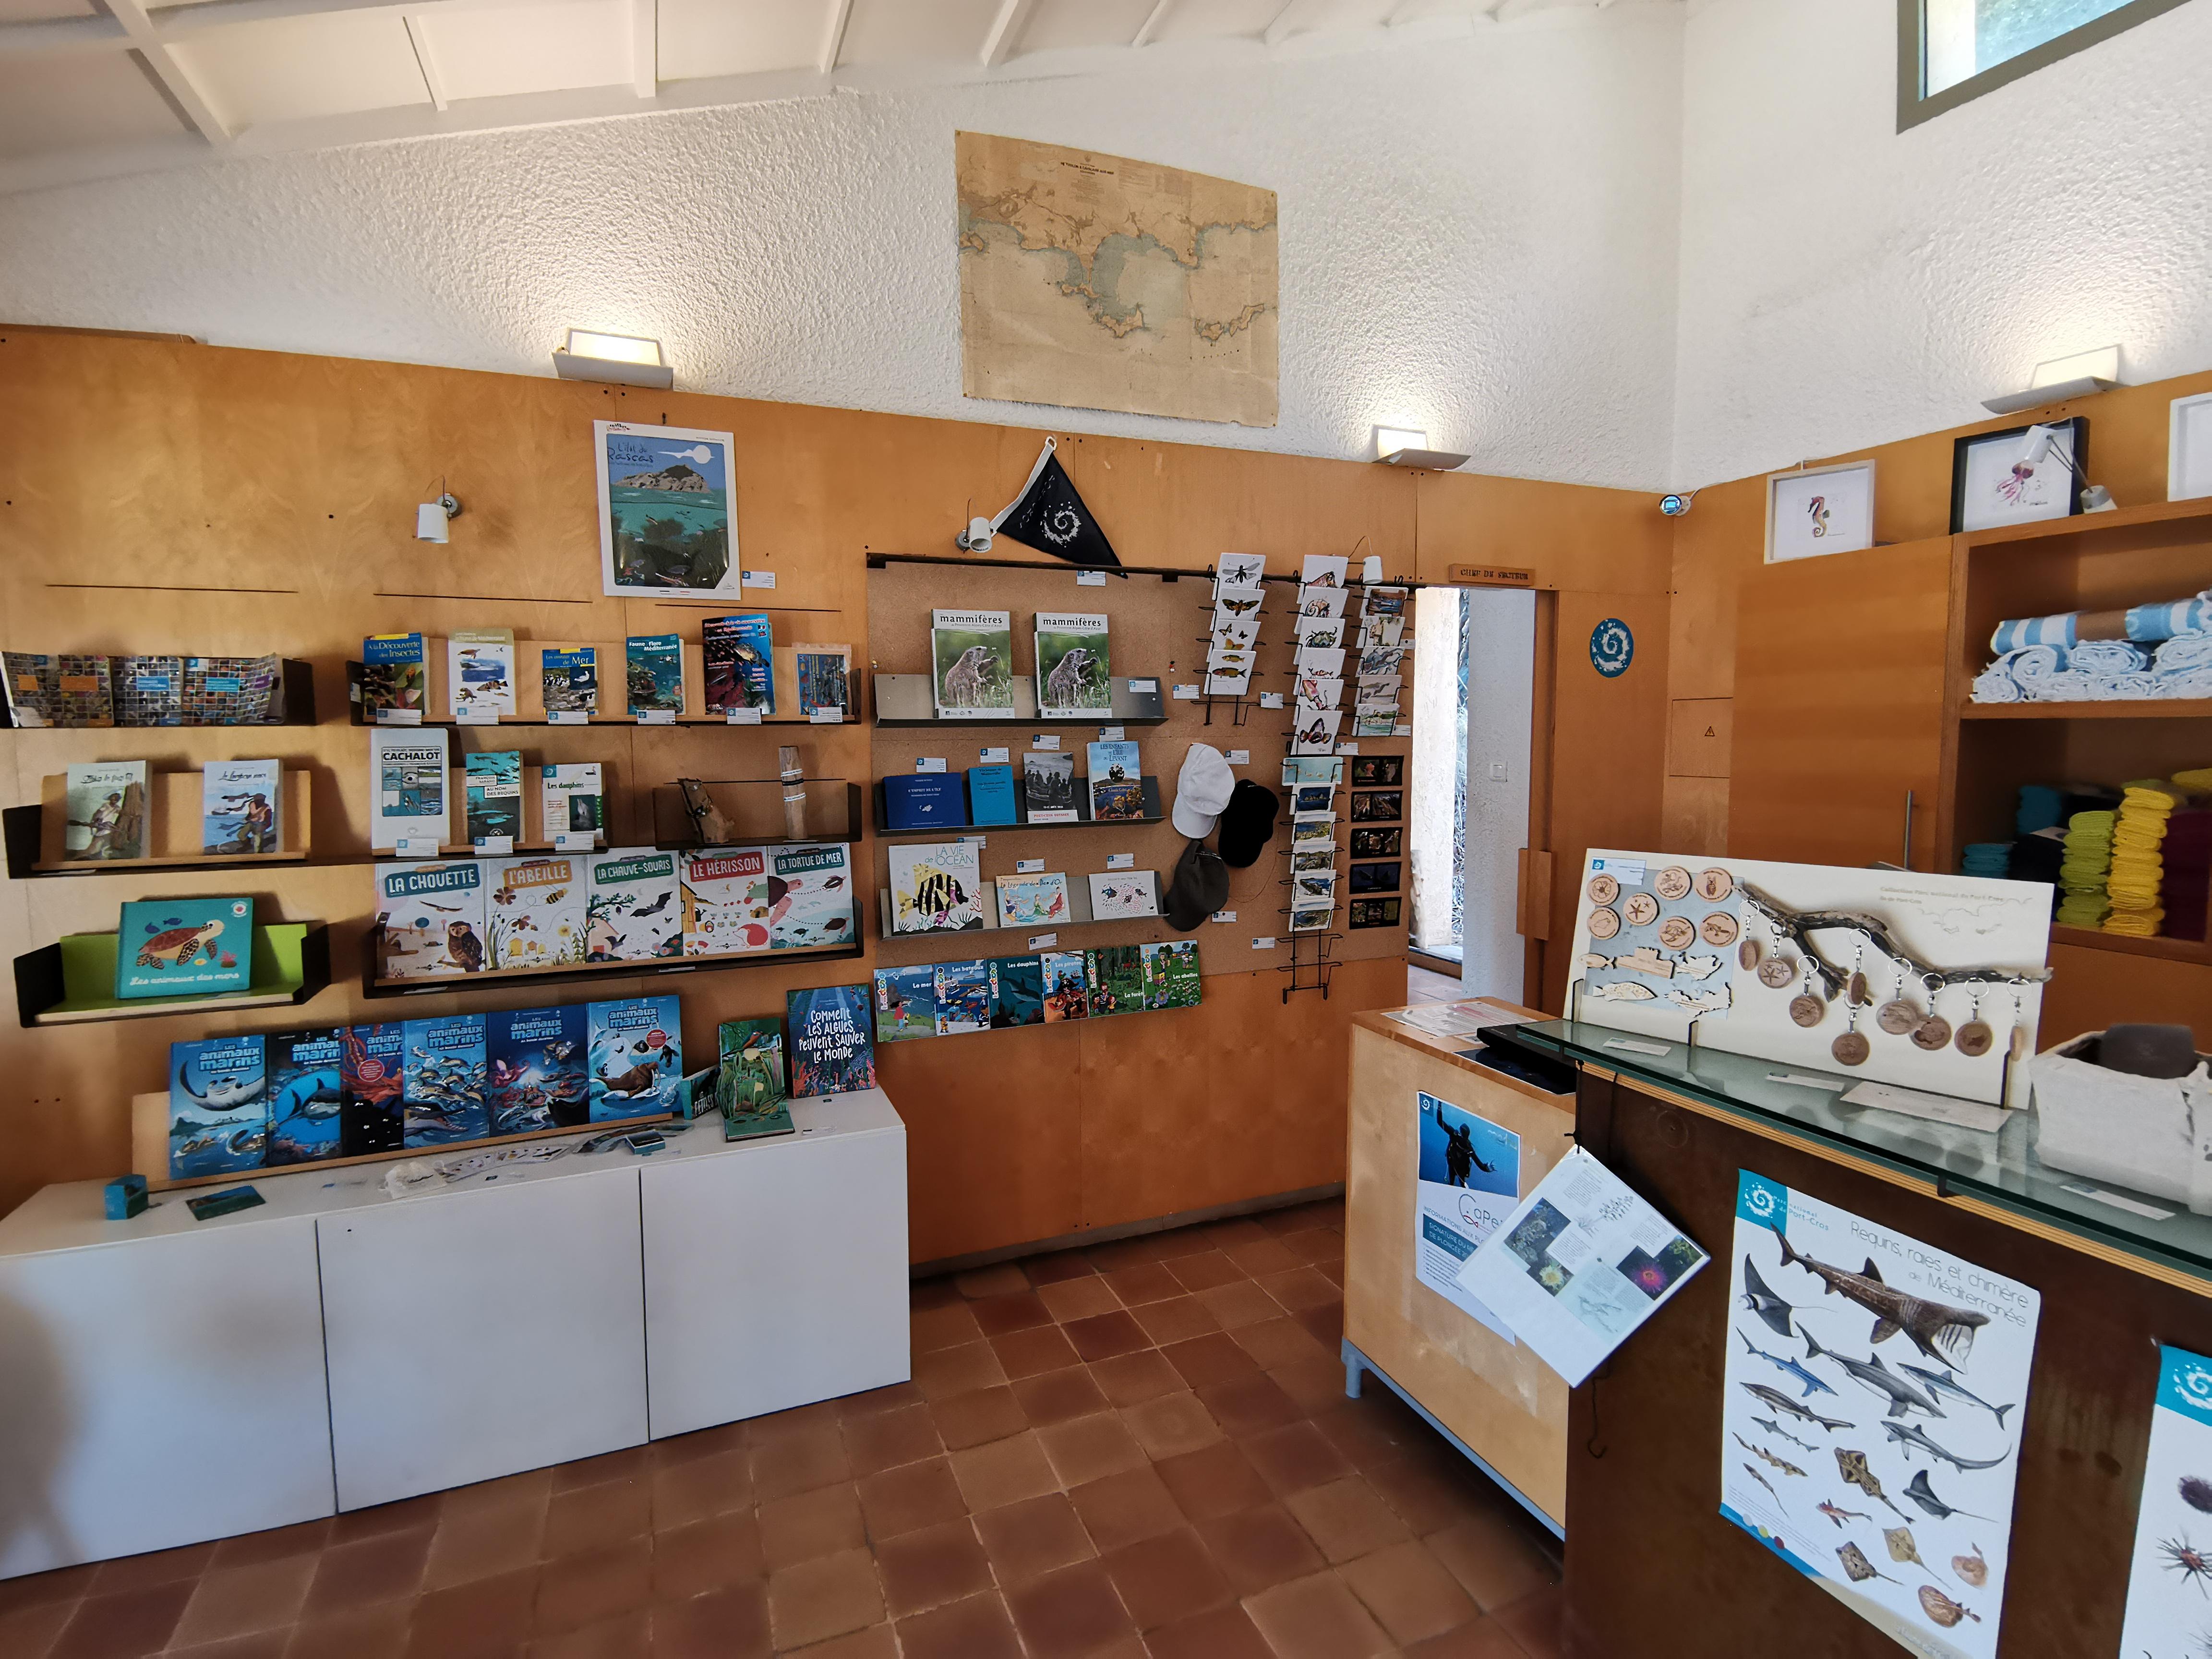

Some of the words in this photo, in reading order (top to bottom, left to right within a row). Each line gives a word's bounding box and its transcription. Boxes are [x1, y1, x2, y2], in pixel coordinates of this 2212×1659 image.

[607, 447, 653, 463] Rascas
[1460, 569, 1481, 577] CHEF
[1498, 571, 1528, 580] SECTEUR
[940, 614, 1002, 624] mammifères
[1043, 617, 1101, 626] mammifères
[379, 641, 420, 649] Découverte
[389, 648, 420, 658] Insectes
[572, 656, 589, 664] Mer
[384, 752, 440, 760] CACHALOT
[558, 781, 585, 790] dauphins
[936, 846, 948, 856] LA
[951, 845, 964, 855] VIE
[692, 864, 705, 878] LE
[707, 857, 761, 876] HÉRISSON
[777, 858, 787, 870] LA
[787, 856, 815, 868] TORTUE
[815, 855, 826, 865] DE
[826, 853, 842, 864] MER
[509, 864, 568, 885] L'ABEILLE
[597, 867, 607, 880] LA
[608, 859, 671, 878] CHAUVE-SOURIS
[388, 878, 405, 893] LA
[409, 868, 476, 890] CHOUETTE
[130, 976, 149, 986] Les
[150, 975, 195, 984] animaux
[197, 973, 213, 981] des
[609, 1008, 658, 1020] animaux
[511, 1019, 562, 1031] animaux
[610, 1015, 658, 1027] marins
[428, 1026, 483, 1038] animaux
[511, 1026, 562, 1040] marins
[429, 1033, 483, 1047] marins
[200, 1047, 260, 1060] animaux
[200, 1056, 260, 1070] marins
[1773, 1195, 1787, 1205] Parc
[1789, 1202, 1817, 1218] national
[1423, 1205, 1463, 1232] INFORMATIONS
[1463, 1228, 1473, 1238] AUX
[1789, 1208, 1829, 1231] Port-Cros
[1429, 1230, 1436, 1240] DE
[1851, 1220, 1902, 1257] Requins,
[1907, 1248, 1943, 1272] raies
[1948, 1264, 1962, 1281] et
[1968, 1272, 2029, 1309] chimère
[1908, 1271, 1922, 1282] de
[1928, 1272, 2027, 1328] Méditerranée
